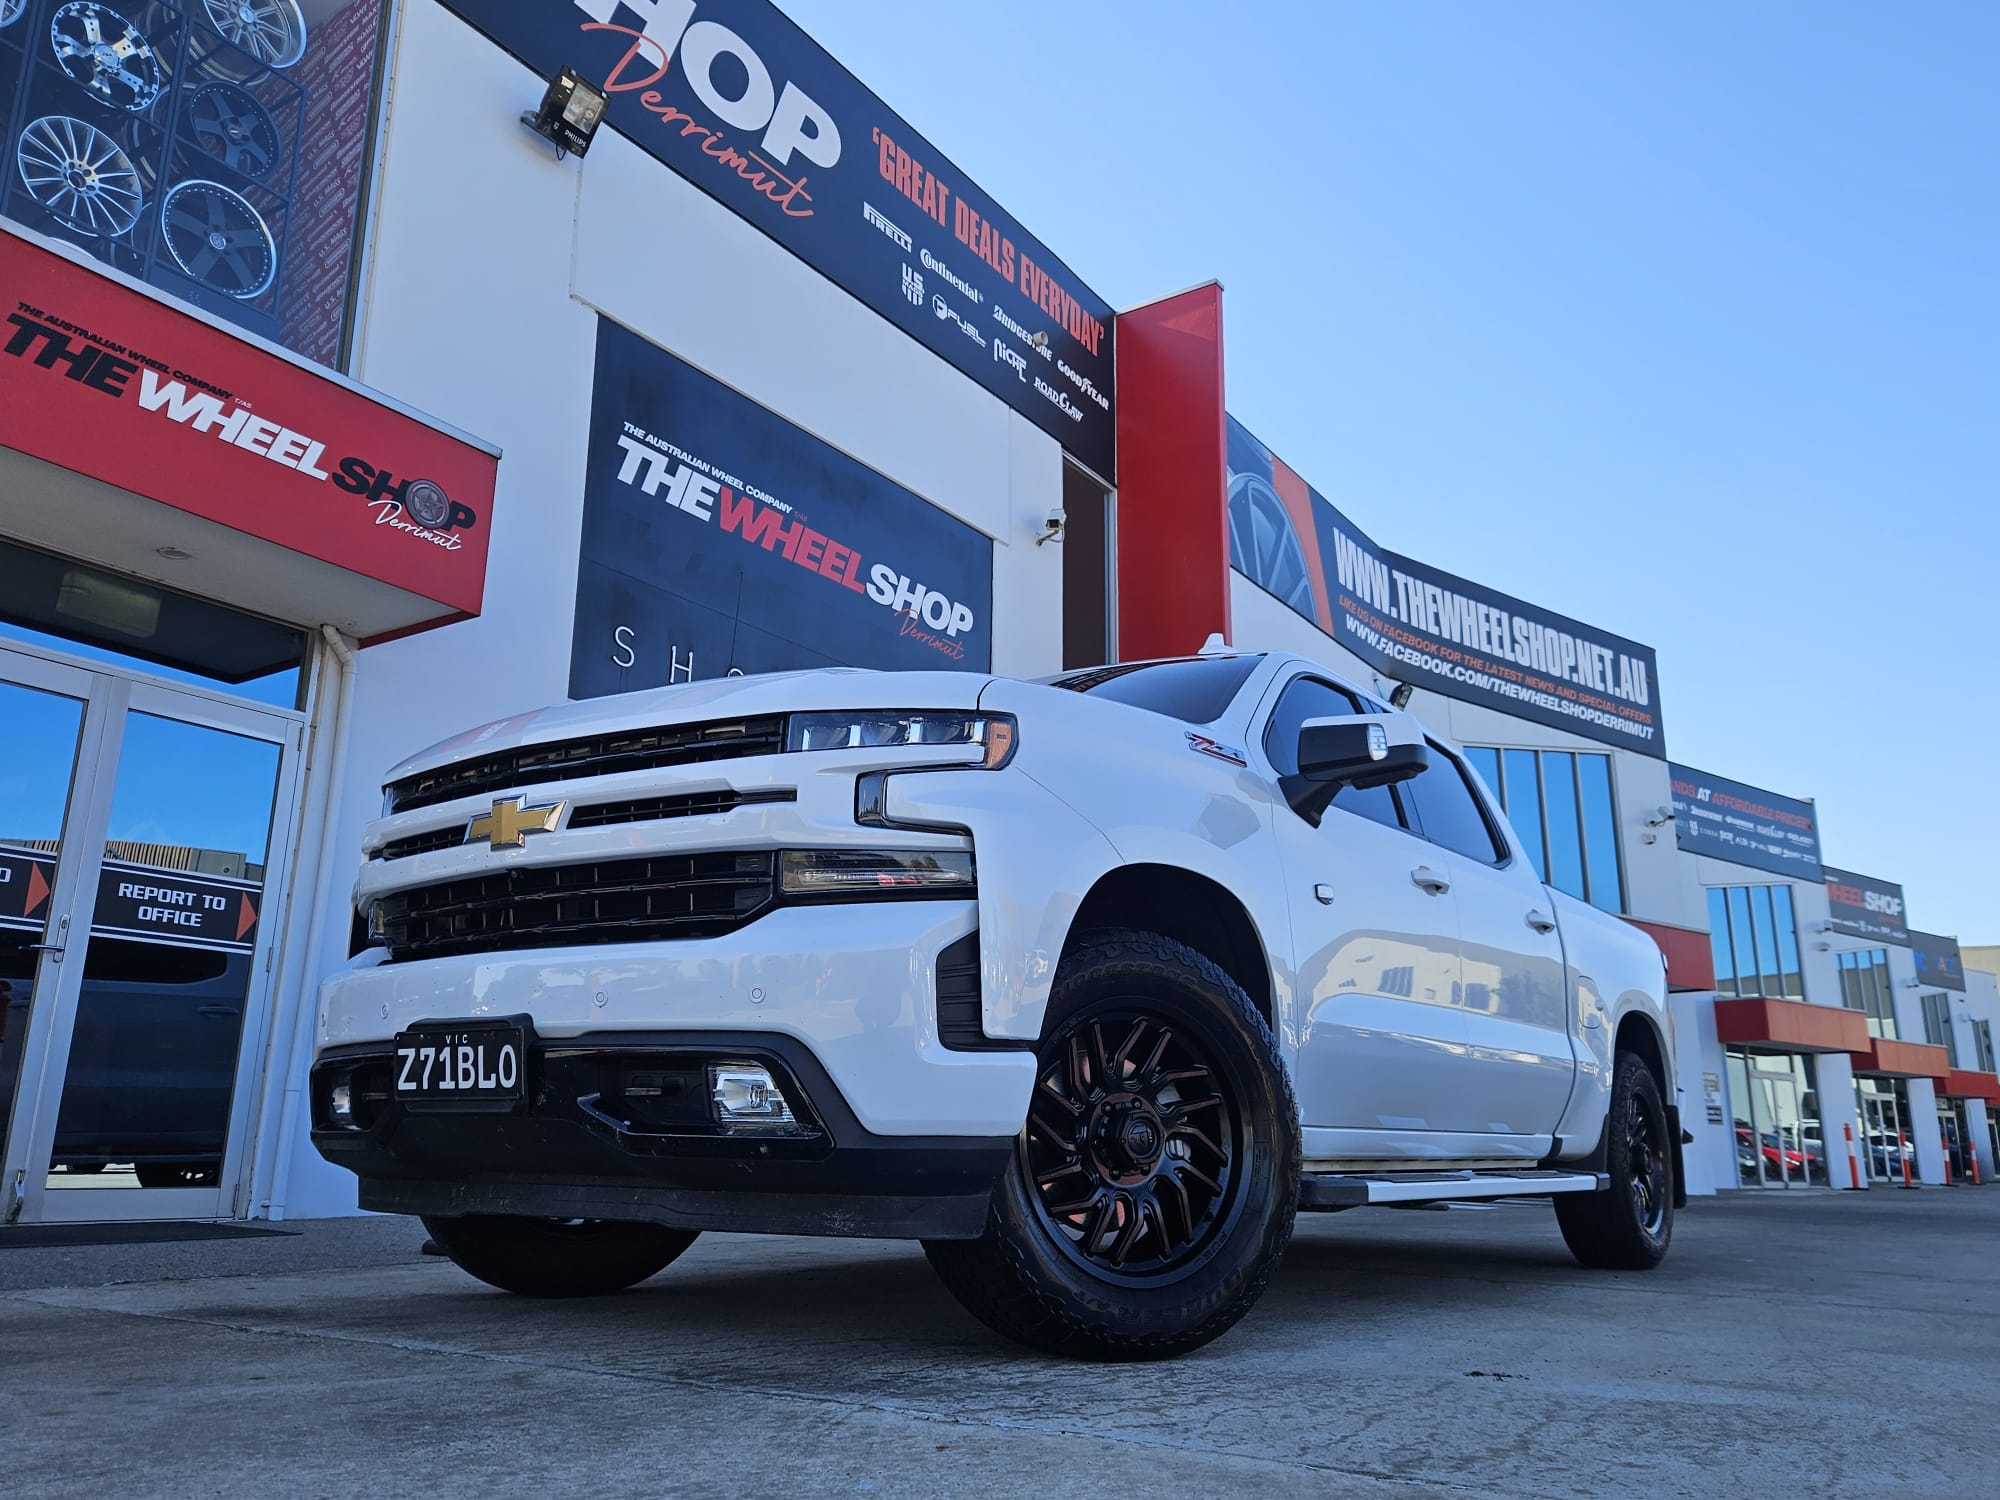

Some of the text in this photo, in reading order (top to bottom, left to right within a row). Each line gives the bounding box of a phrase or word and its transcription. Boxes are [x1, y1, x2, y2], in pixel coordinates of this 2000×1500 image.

[564, 129, 587, 148] PHILIPS
[581, 23, 814, 217] Derrimut
[864, 201, 913, 253] PIRELLI
[955, 196, 1015, 284] DEALS
[18, 302, 44, 319] THE
[44, 315, 127, 355] AUSTRALIAN
[128, 350, 170, 375] WHEEL
[172, 370, 233, 400] COMPANY
[4, 312, 140, 398] THE
[138, 368, 329, 481] WHEEL
[1057, 360, 1109, 411] GOODYEAR
[623, 421, 646, 439] THE
[645, 433, 711, 473] AUSTRALIAN
[711, 466, 745, 492] WHEEL
[746, 485, 793, 514] COMPANY
[368, 500, 462, 551] Derrimut
[617, 434, 974, 638] THE WHEEL SHOP
[894, 607, 965, 660] Derrimut
[1333, 527, 1649, 706] WWW.THEWHEELSHOP.NET.AU
[1339, 594, 1653, 724] LIKE US ON FACEBOOK FOR THE LATEST NEWS AND SPECIAL OFFERS
[1346, 613, 1654, 740] WWW.FACEBOOK.COM/THEWHEELSHOPDERRIMUT
[1697, 787, 1711, 802] AT
[1712, 792, 1774, 820] AFFORDABLE
[118, 882, 226, 911] REPORT TO
[137, 906, 203, 927] OFFICE
[1864, 891, 1903, 916] SHOP
[445, 1034, 469, 1045] VIC
